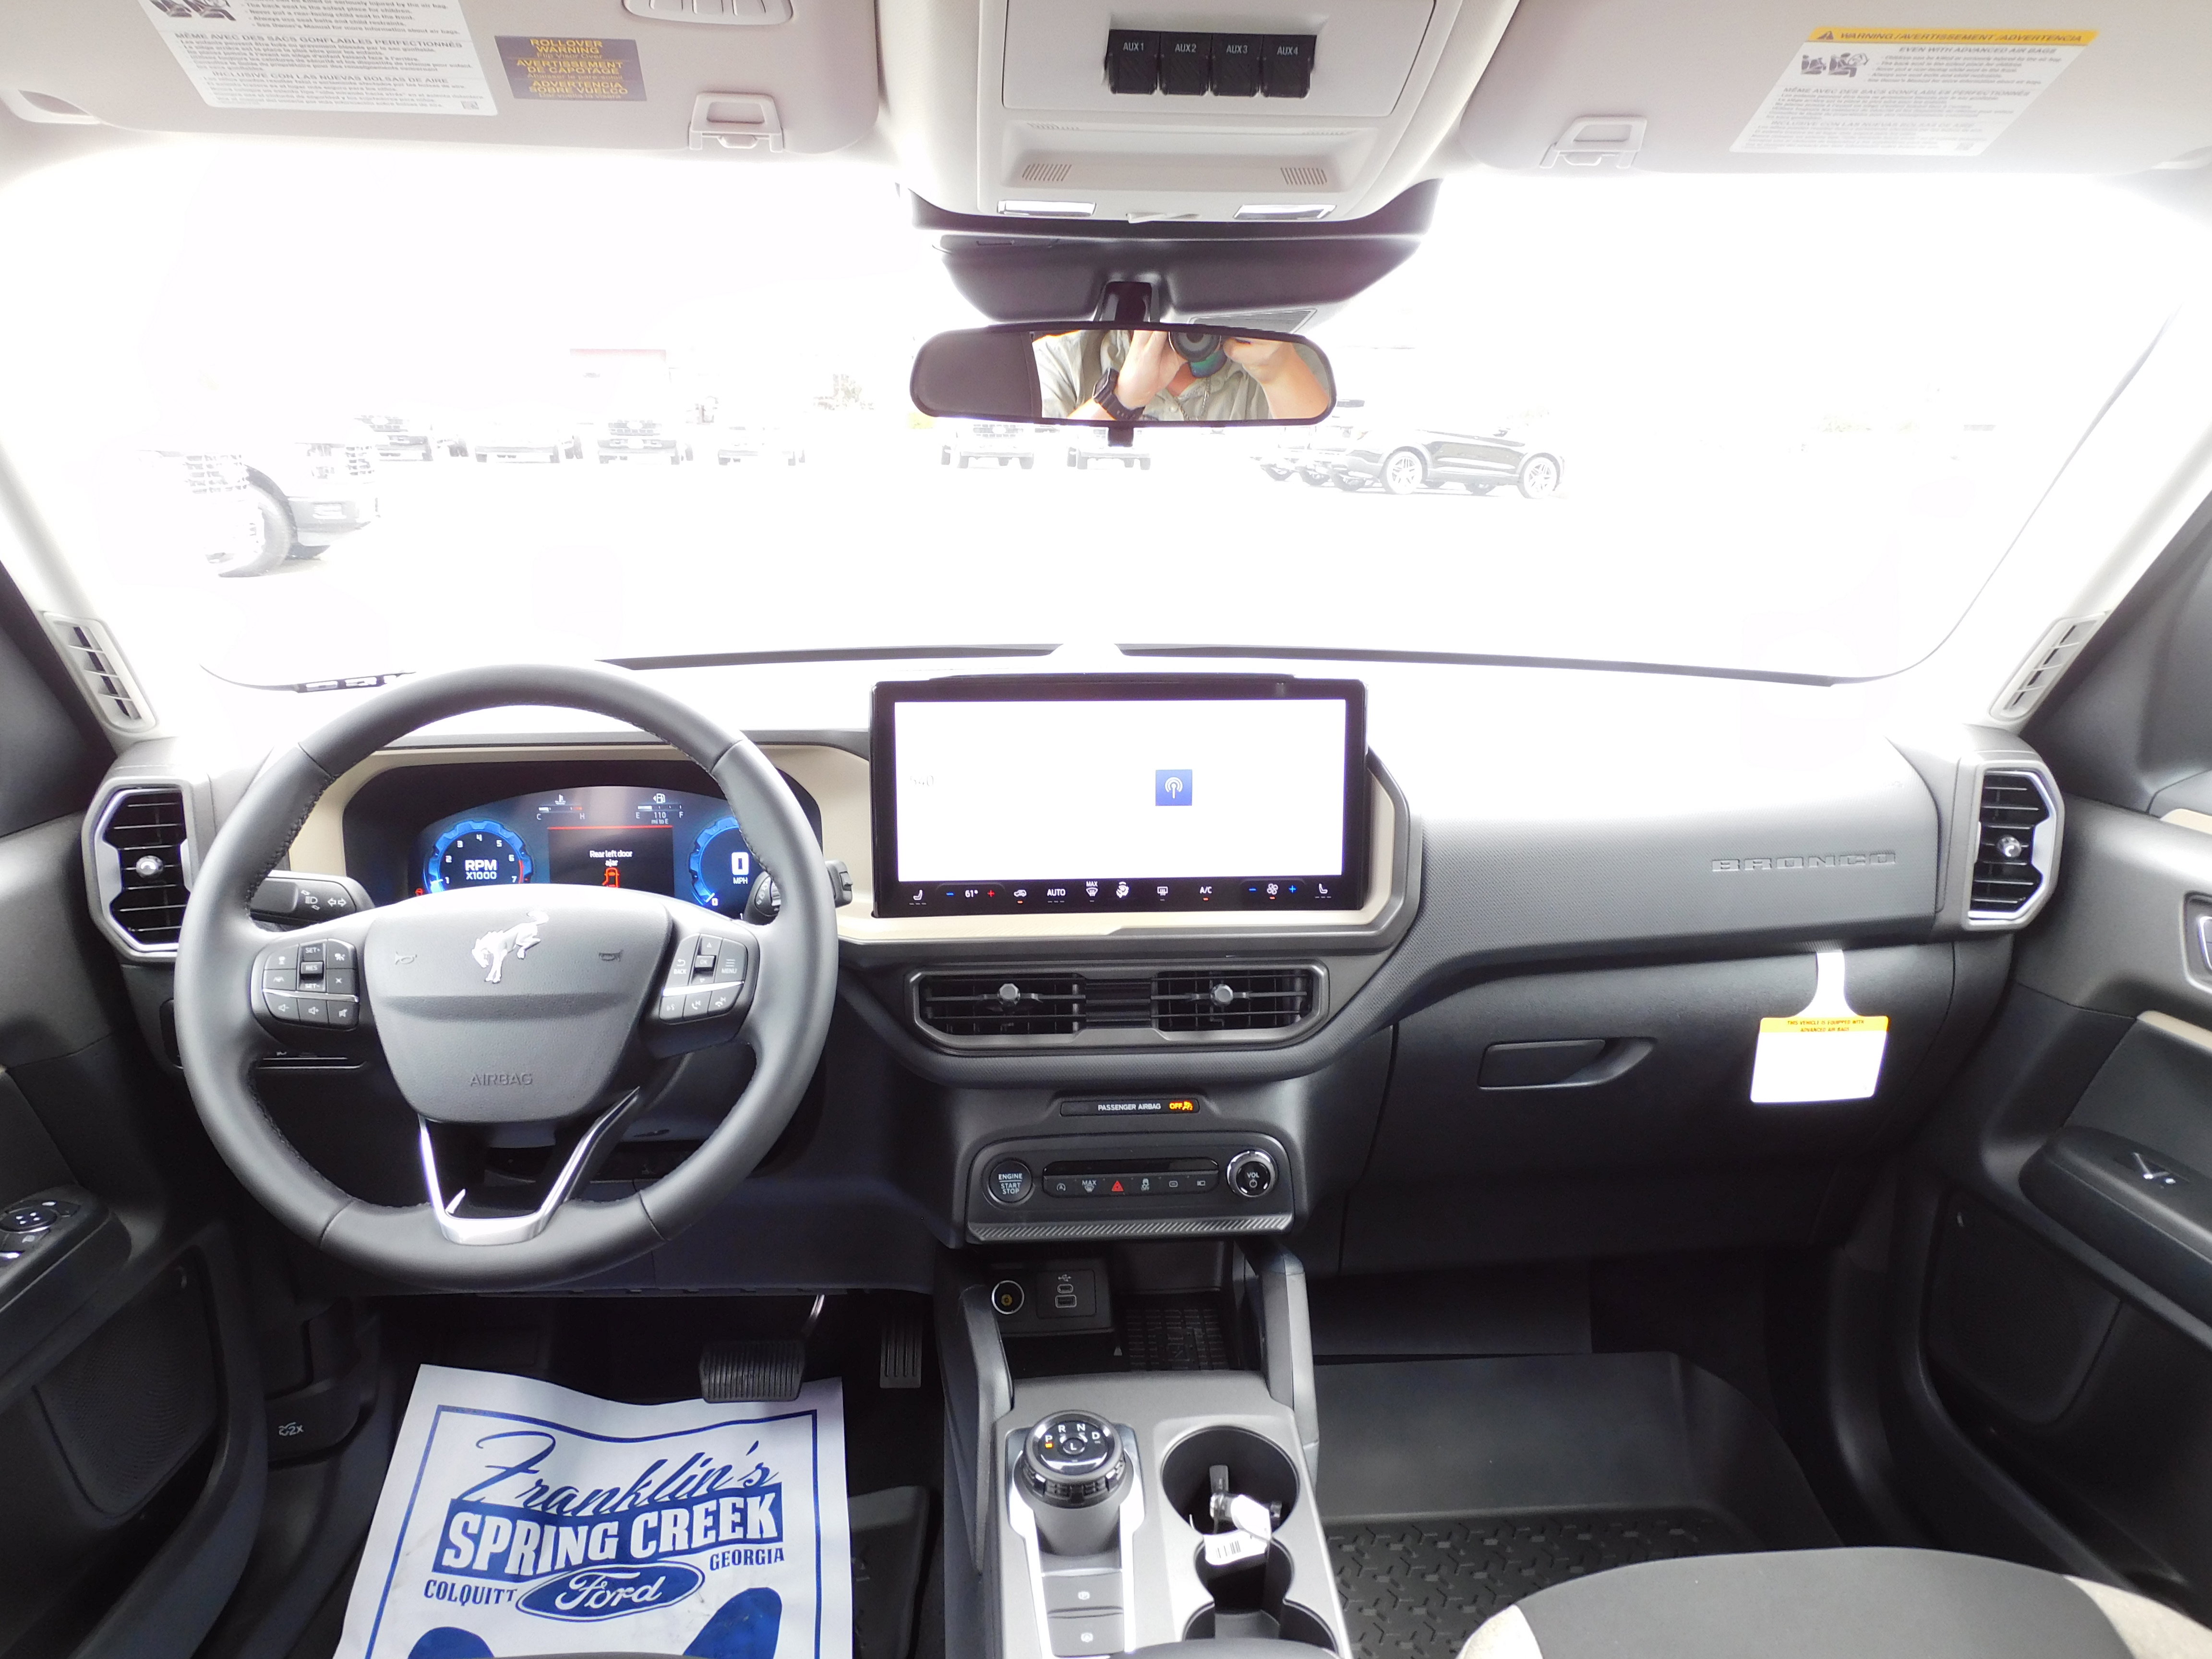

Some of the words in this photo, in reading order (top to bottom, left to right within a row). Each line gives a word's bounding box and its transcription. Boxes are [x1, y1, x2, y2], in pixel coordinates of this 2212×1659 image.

[530, 39, 603, 48] ROLLOVER
[537, 46, 600, 54] WARNING
[517, 60, 623, 69] AVERTISSEMENT
[465, 859, 497, 871] RPM
[732, 852, 749, 875] 0
[1712, 853, 1896, 872] BRONCO
[1047, 889, 1066, 897] AUTO
[470, 1073, 533, 1087] AIRBAG
[1058, 1425, 1066, 1433] R
[455, 1431, 779, 1516] Franklin's
[442, 1512, 620, 1577] SPRING
[630, 1492, 778, 1560] CREEK
[709, 1548, 785, 1571] GEORGIA
[424, 1579, 517, 1607] COLQUITT
[554, 1568, 662, 1611] Ford
